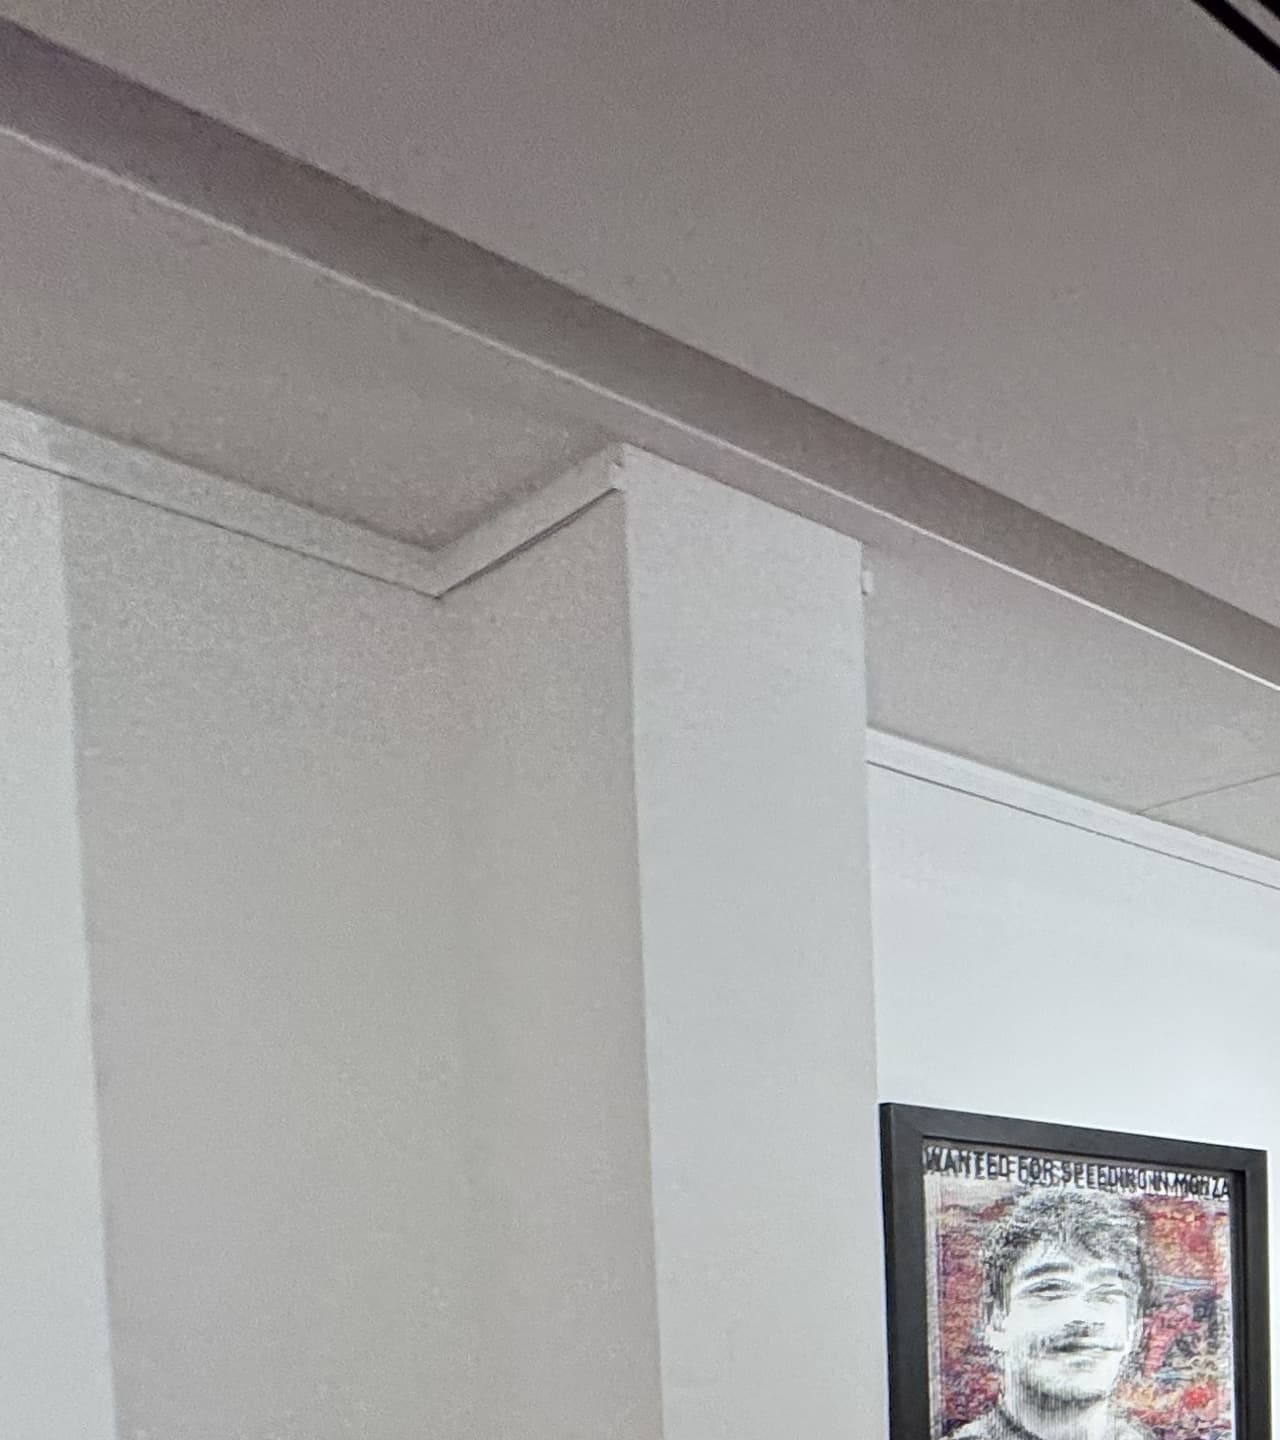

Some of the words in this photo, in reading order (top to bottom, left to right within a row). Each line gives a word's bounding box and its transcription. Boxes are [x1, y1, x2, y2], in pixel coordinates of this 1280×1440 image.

[926, 1146, 1010, 1179] WANTED
[1018, 1155, 1053, 1184] FOR
[1061, 1160, 1148, 1192] SPEEDING
[1174, 1174, 1231, 1199] MONZA
